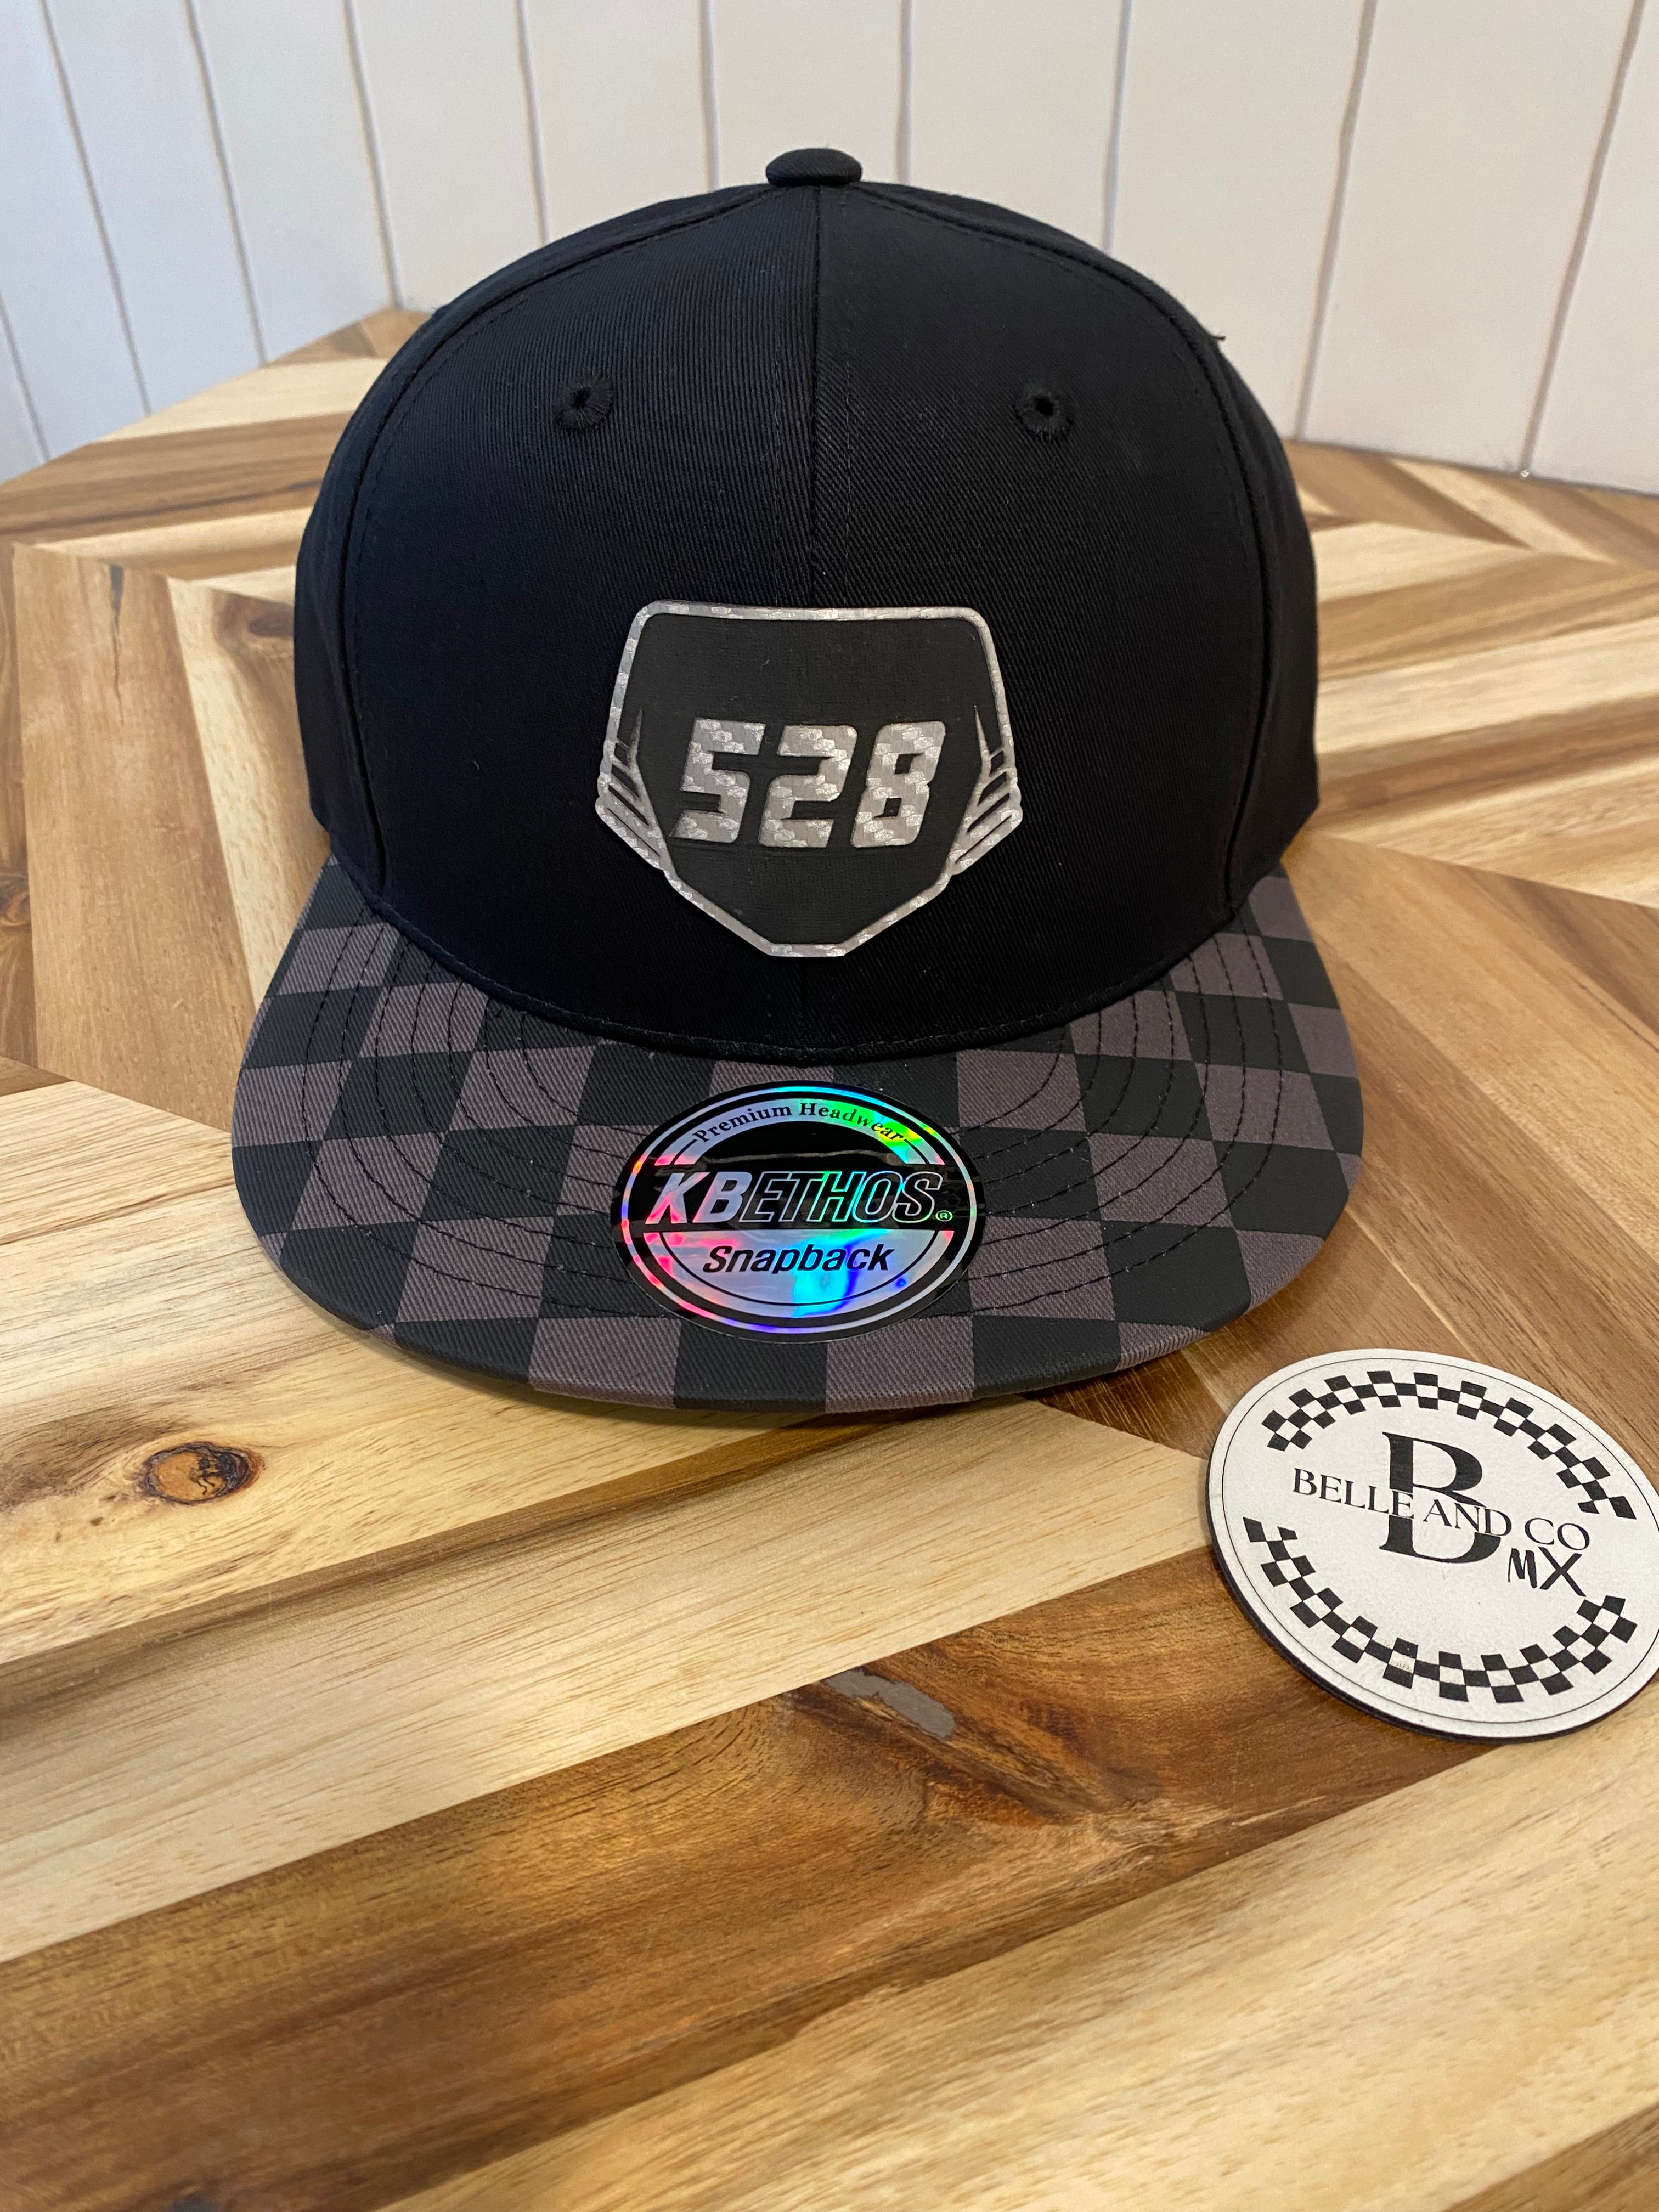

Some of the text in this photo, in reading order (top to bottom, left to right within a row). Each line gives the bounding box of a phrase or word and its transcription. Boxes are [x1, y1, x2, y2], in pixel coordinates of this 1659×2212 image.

[669, 717, 946, 848] 528
[692, 1101, 904, 1143] Premium Headwear
[702, 1244, 895, 1275] Snapback
[1293, 1468, 1591, 1551] BELLE AND CO
[1507, 1546, 1587, 1598] MX
